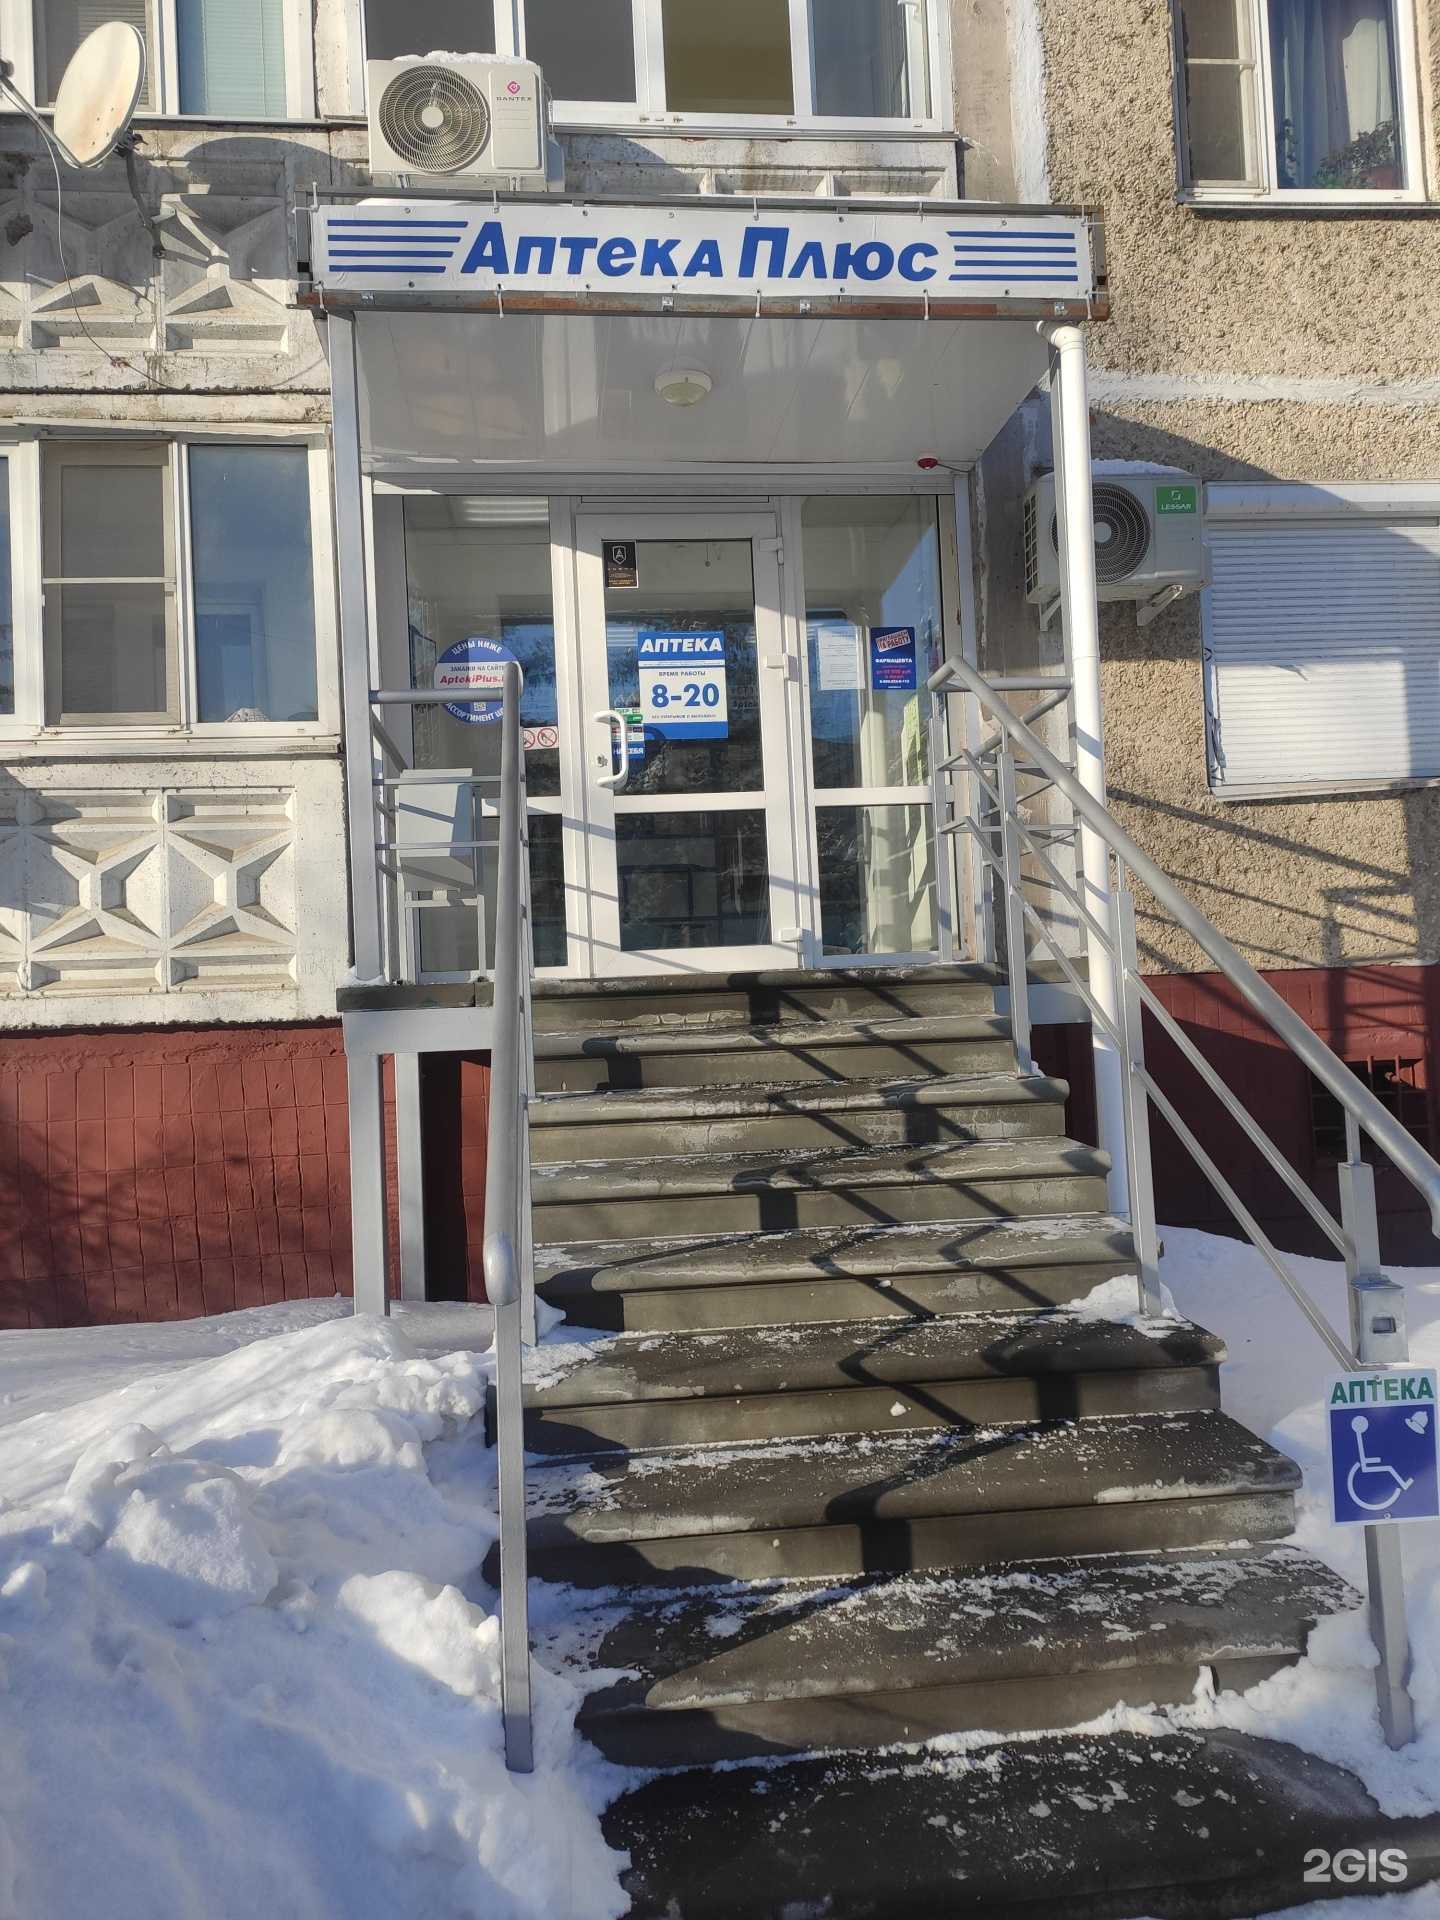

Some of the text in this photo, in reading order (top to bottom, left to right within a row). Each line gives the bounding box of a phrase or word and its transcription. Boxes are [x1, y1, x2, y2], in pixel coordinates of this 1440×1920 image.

[460, 221, 939, 281] Аптека Плюс
[451, 640, 503, 655] ЦЕНЫ НИЖЕ
[640, 637, 723, 653] АПТЕКА
[651, 683, 720, 708] 8-20
[1330, 1377, 1434, 1404] АПТЕКА
